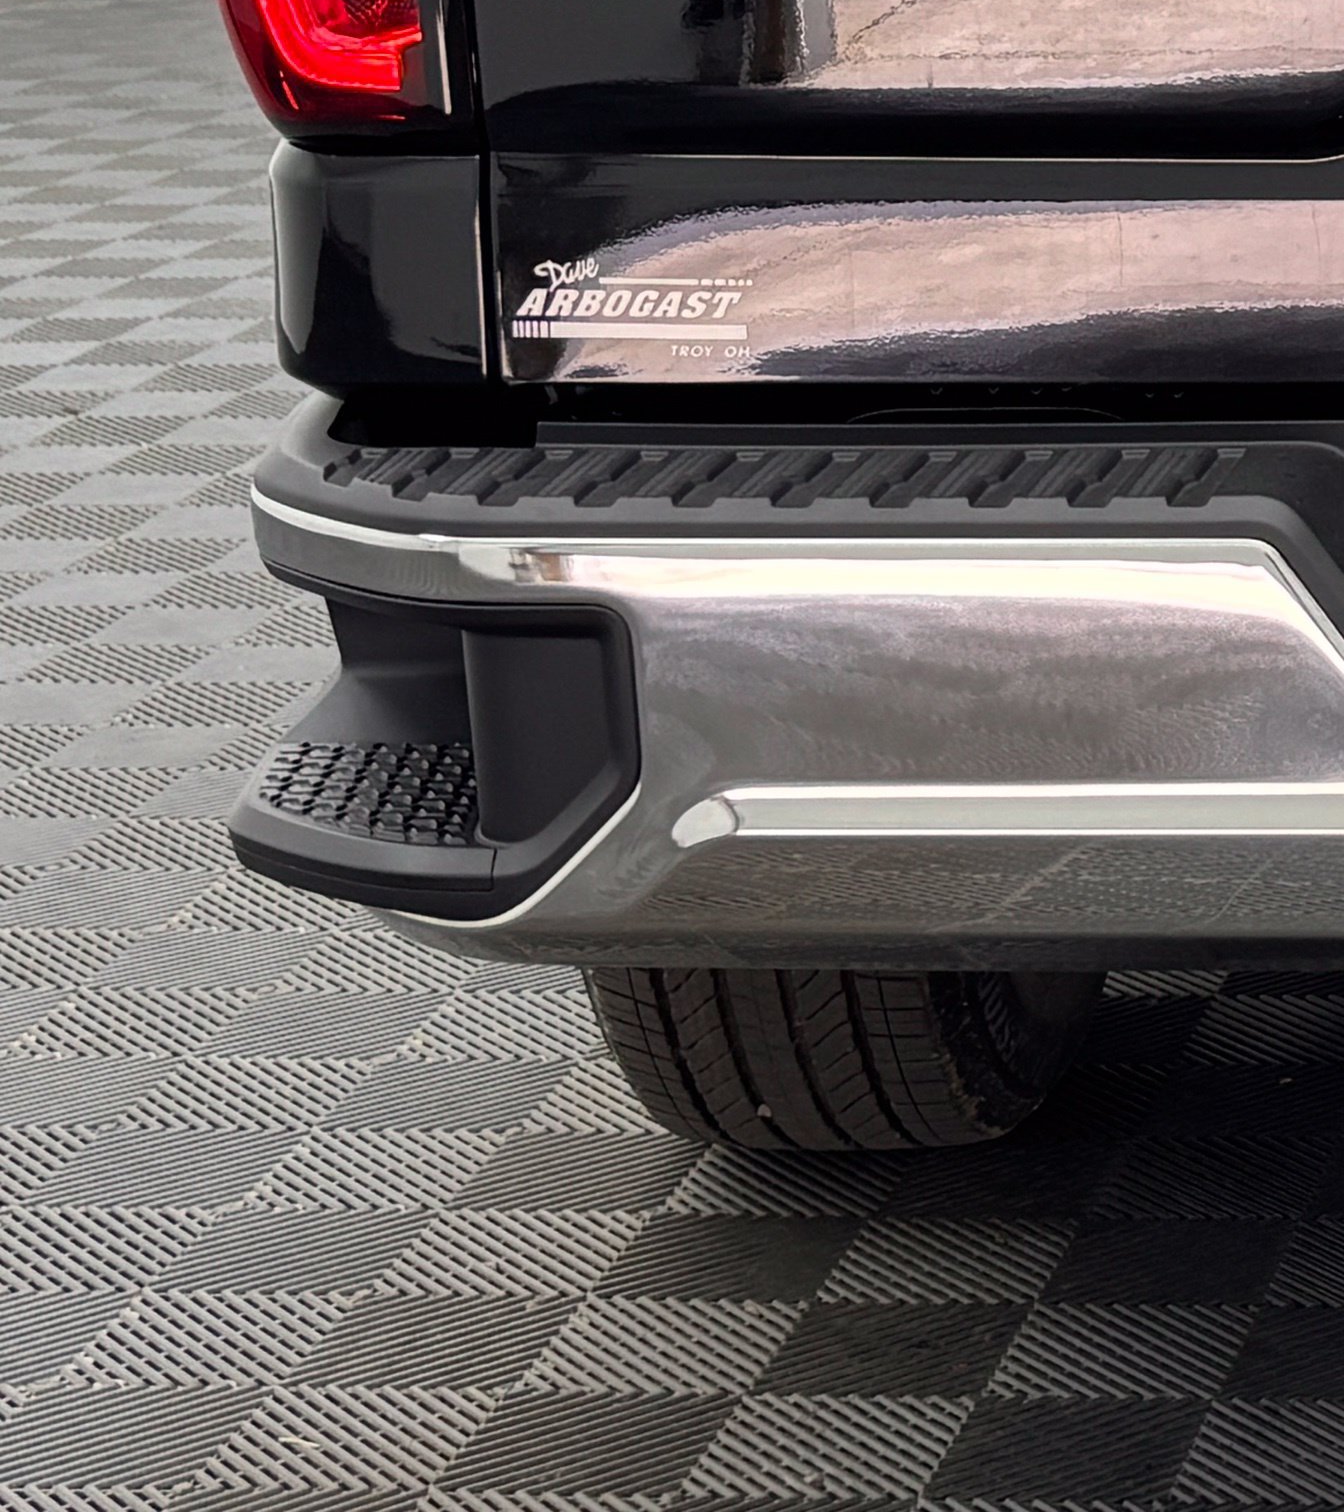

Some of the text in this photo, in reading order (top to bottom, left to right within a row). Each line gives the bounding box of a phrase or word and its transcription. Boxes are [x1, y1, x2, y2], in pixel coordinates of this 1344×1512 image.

[534, 257, 599, 292] Dave
[516, 287, 742, 319] ARBOGAST
[671, 345, 750, 358] TROY OH
